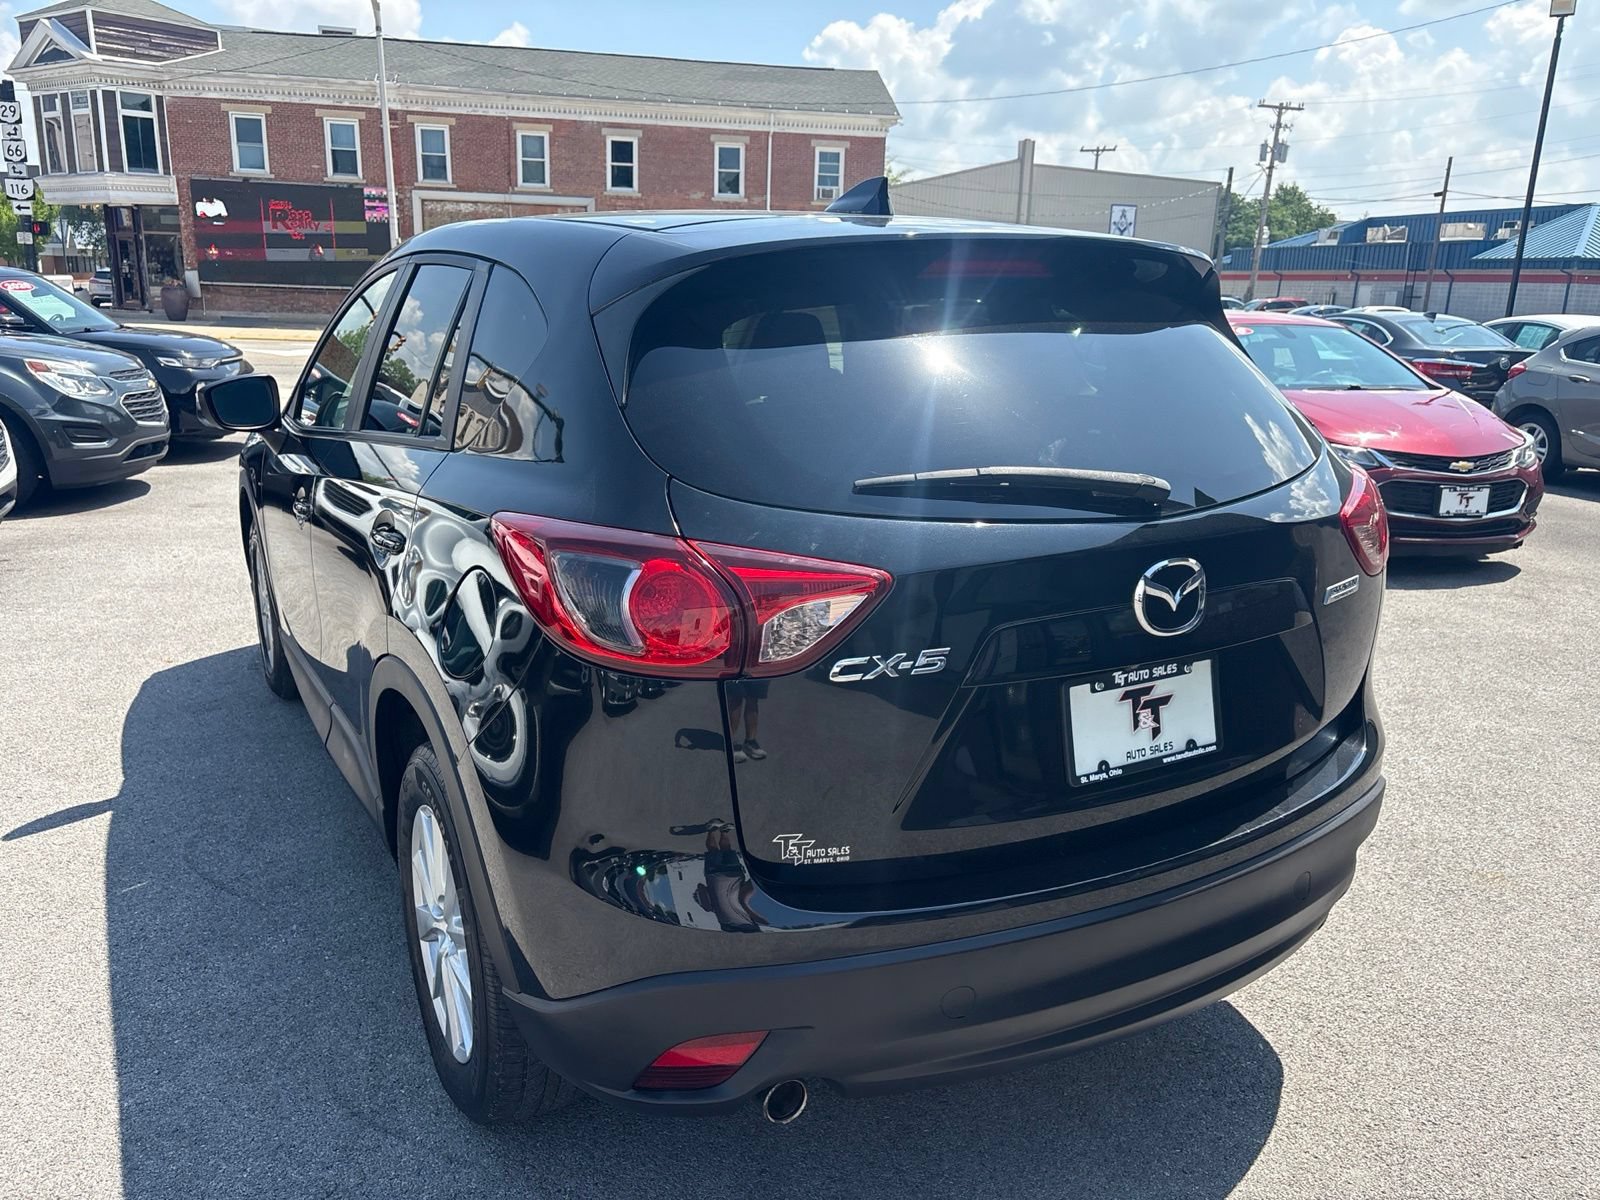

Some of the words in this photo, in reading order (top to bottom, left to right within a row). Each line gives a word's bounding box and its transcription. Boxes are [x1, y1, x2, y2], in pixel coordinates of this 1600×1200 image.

[0, 105, 16, 118] 29
[7, 145, 22, 157] 66
[10, 184, 28, 195] 116
[829, 647, 951, 683] CX-5
[1128, 669, 1149, 683] AUTO
[1152, 663, 1177, 678] SALES
[1117, 684, 1175, 742] T&T
[1126, 747, 1147, 761] AUTO
[1149, 741, 1174, 756] SALES
[1109, 768, 1123, 777] Ohio
[806, 848, 826, 858] AUTO
[827, 846, 850, 856] SALES
